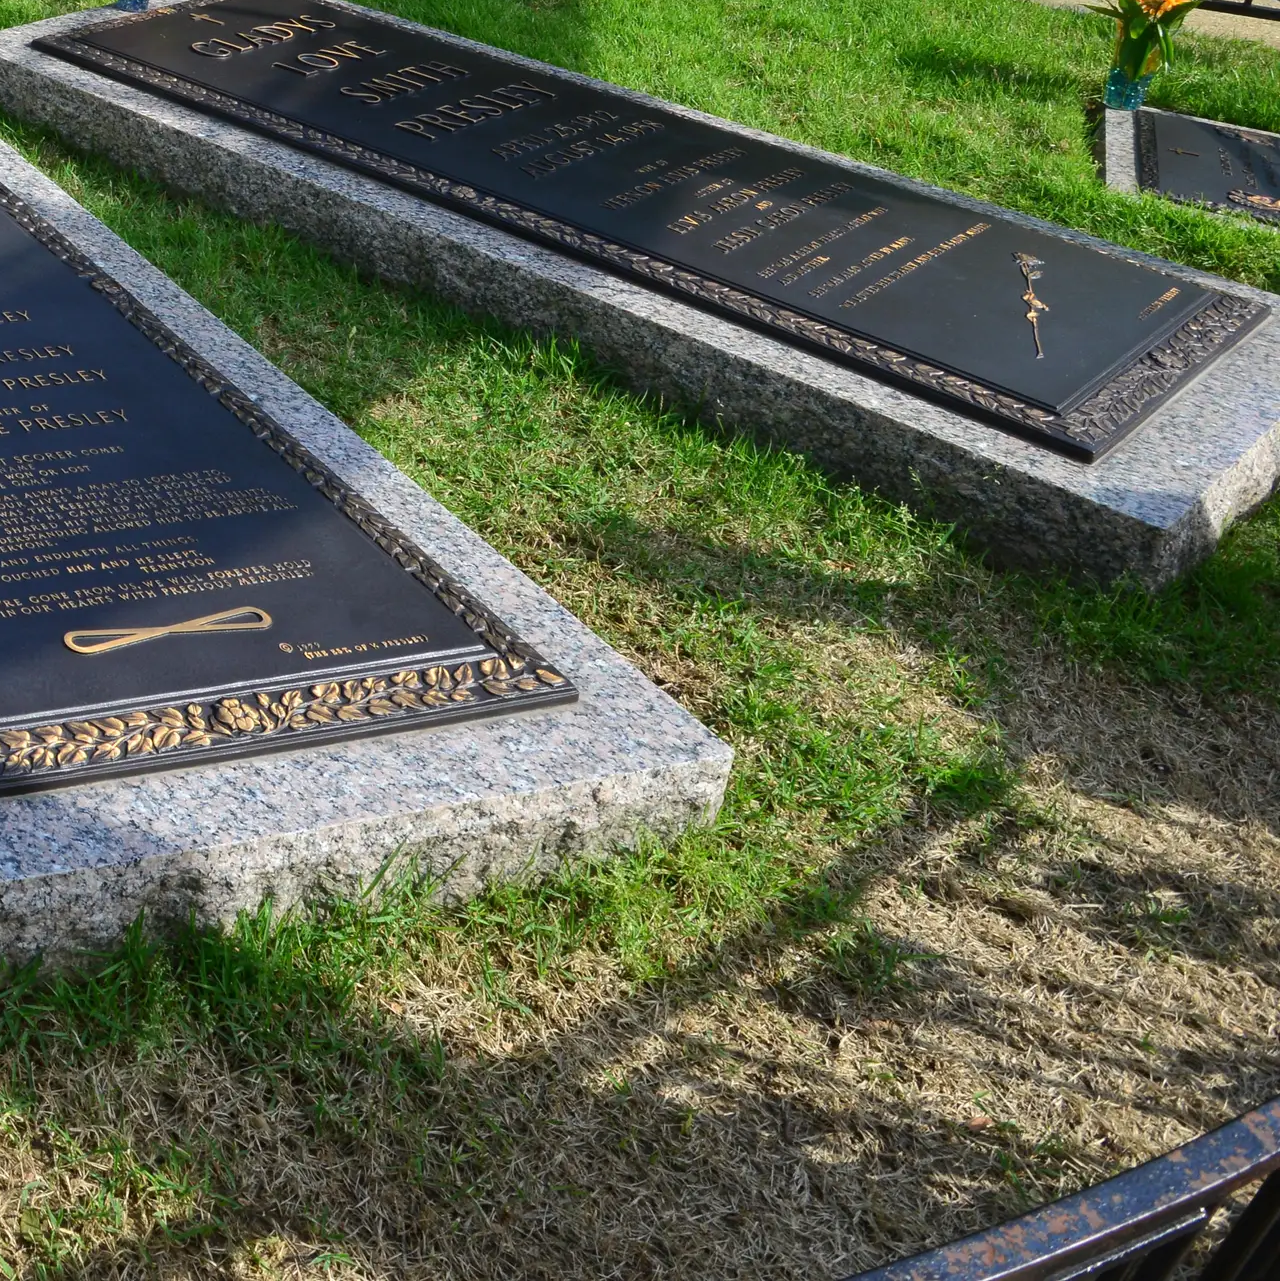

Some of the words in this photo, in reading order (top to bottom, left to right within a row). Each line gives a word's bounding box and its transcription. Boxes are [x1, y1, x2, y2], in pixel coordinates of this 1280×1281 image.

[190, 14, 336, 61] GLADYS
[271, 40, 387, 78] LOVE
[340, 60, 469, 106] SMITH
[394, 80, 556, 140] PRESLEY
[486, 132, 553, 161] APRIL
[568, 108, 620, 129] 1912
[517, 140, 604, 177] AUGUST
[616, 118, 666, 138] 1958
[600, 181, 663, 210] VERNON
[656, 165, 700, 185] ELVIS
[692, 146, 747, 170] PRESLEY
[664, 210, 714, 235] ELVIS
[706, 188, 760, 215] AARON
[752, 166, 808, 193] PRESLEY
[755, 203, 809, 230] GARON
[800, 181, 854, 208] PRESLEY
[1, 368, 107, 391] PRESLEY
[18, 408, 128, 433] PRESLEY
[28, 402, 52, 413] OF
[4, 471, 34, 480] WON
[37, 468, 59, 477] OR
[60, 464, 92, 474] LOST
[13, 449, 77, 464] SCORER
[80, 444, 125, 457] COMES
[34, 546, 109, 563] ENDURETH
[113, 543, 140, 554] ALL
[66, 563, 96, 574] HIM
[99, 559, 130, 570] AND
[134, 555, 155, 565] HE
[139, 557, 216, 574] TENNYSON
